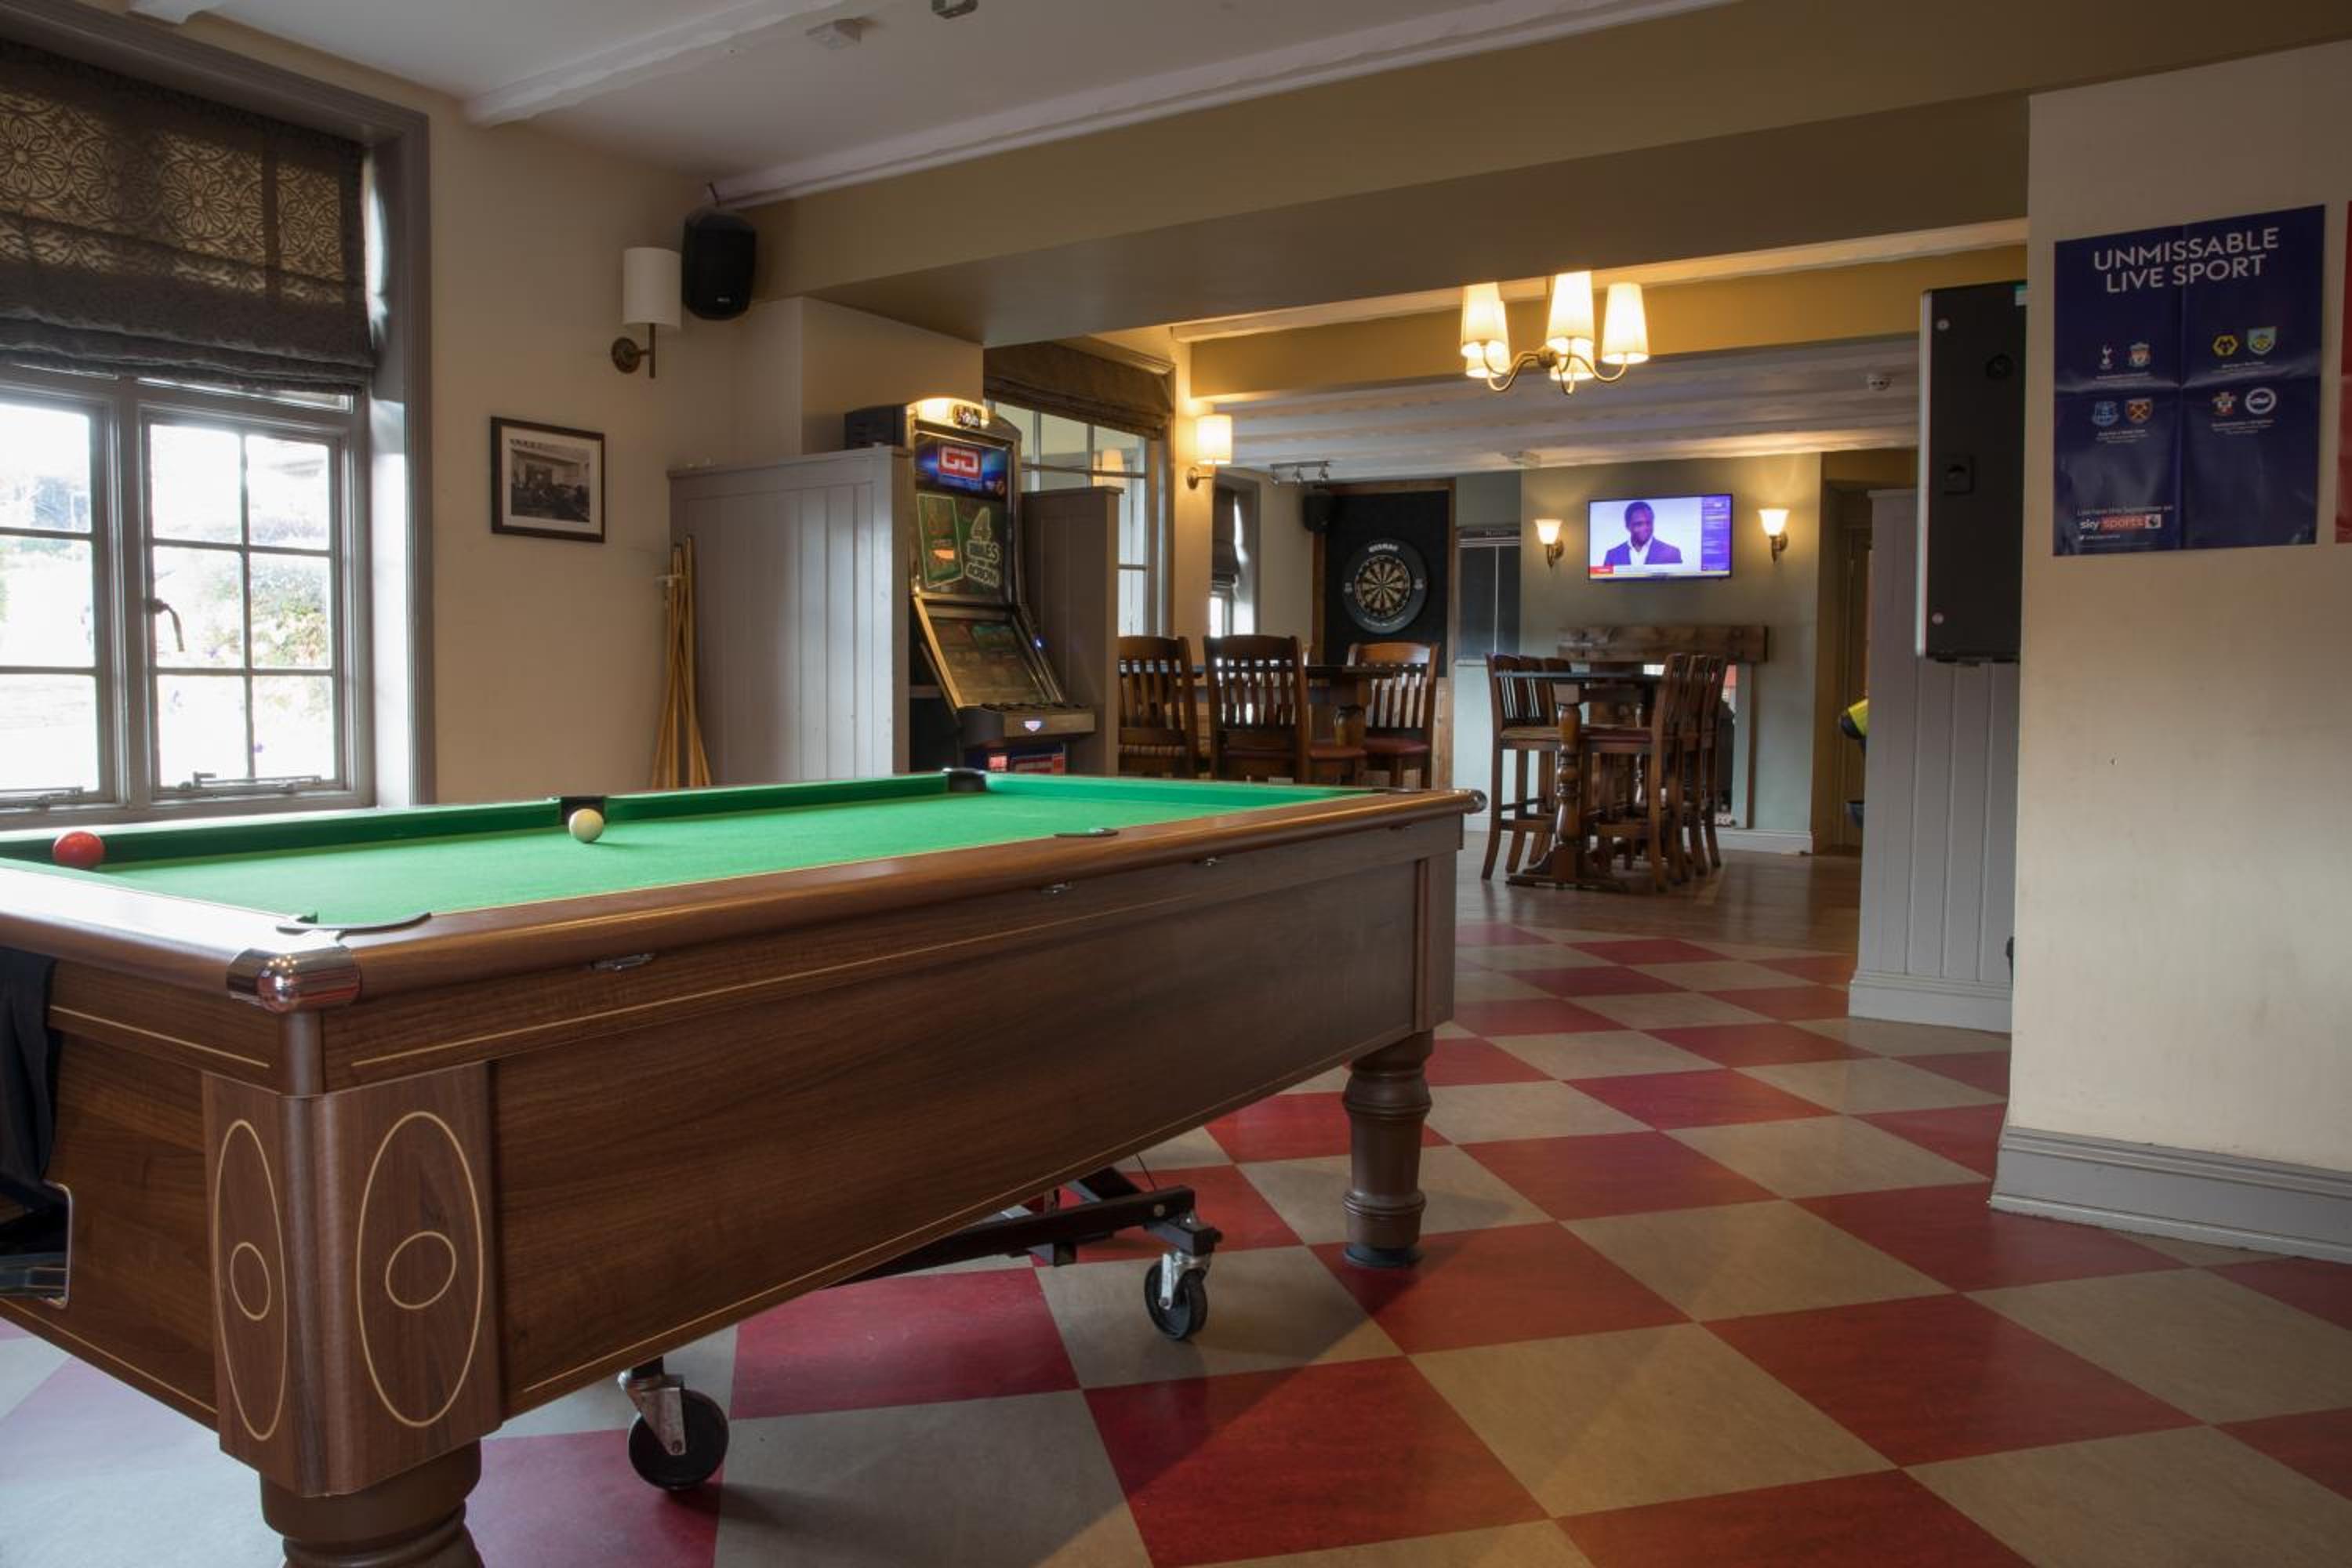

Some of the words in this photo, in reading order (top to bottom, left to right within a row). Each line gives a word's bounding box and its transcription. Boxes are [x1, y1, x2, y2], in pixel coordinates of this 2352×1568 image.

[2093, 227, 2280, 271] UNMISSABLE
[2106, 267, 2165, 293] LIVE
[2172, 253, 2267, 286] SPORT
[2079, 518, 2100, 530] sky
[2102, 517, 2144, 529] sports
